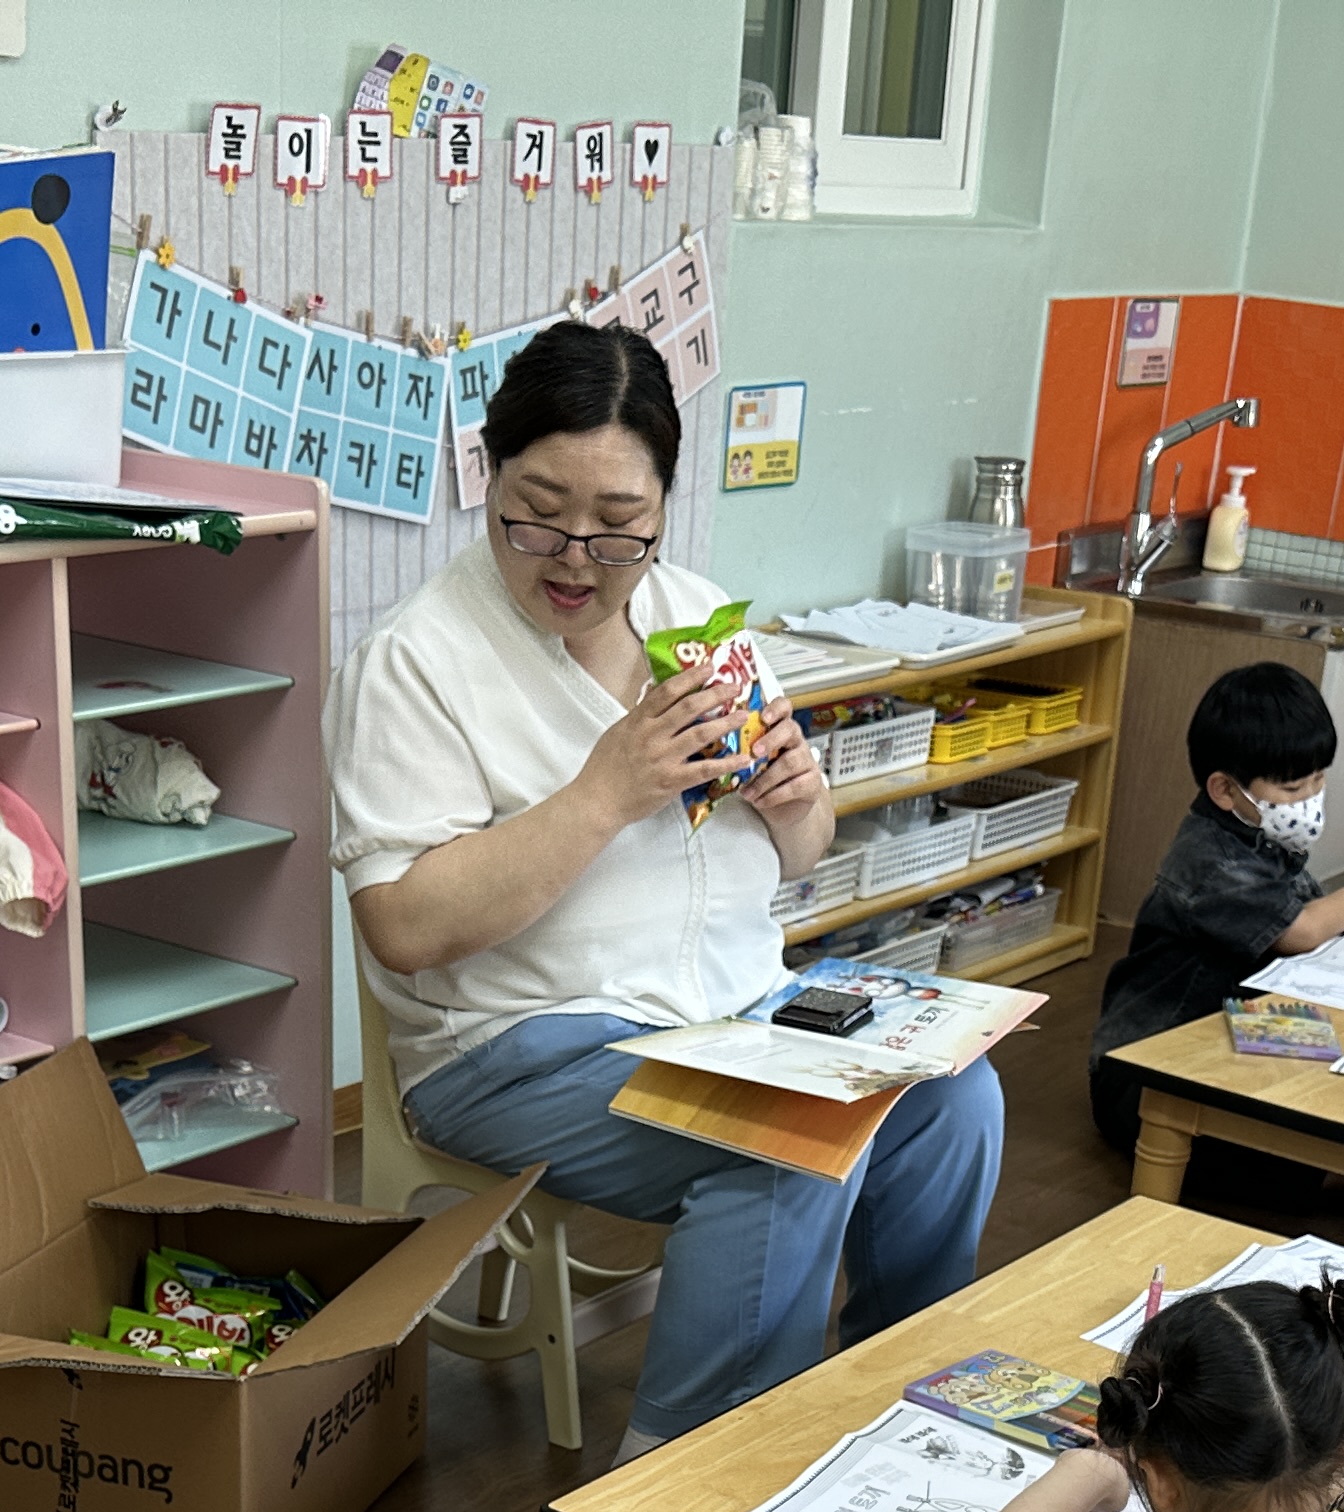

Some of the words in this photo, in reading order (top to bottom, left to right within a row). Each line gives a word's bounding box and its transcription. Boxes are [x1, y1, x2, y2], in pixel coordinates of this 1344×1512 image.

[221, 115, 247, 160] 놀
[288, 127, 313, 174] 이
[357, 121, 382, 163] 는
[449, 123, 472, 164] 즐
[522, 129, 545, 172] 거
[585, 132, 604, 173] 워
[678, 261, 700, 305] 구
[150, 281, 182, 339] 가
[203, 309, 238, 366] 나
[258, 336, 292, 391] 다
[686, 329, 709, 367] 기
[130, 368, 167, 424] 라
[189, 394, 223, 449] 마
[244, 419, 277, 469] 바
[306, 348, 338, 395] 사
[357, 361, 387, 408] 아
[405, 372, 434, 421] 자
[296, 429, 328, 476] 차
[347, 441, 377, 488] 카
[396, 453, 425, 499] 타
[317, 1347, 396, 1457] 로켓프레시
[0, 1436, 174, 1505] coupang
